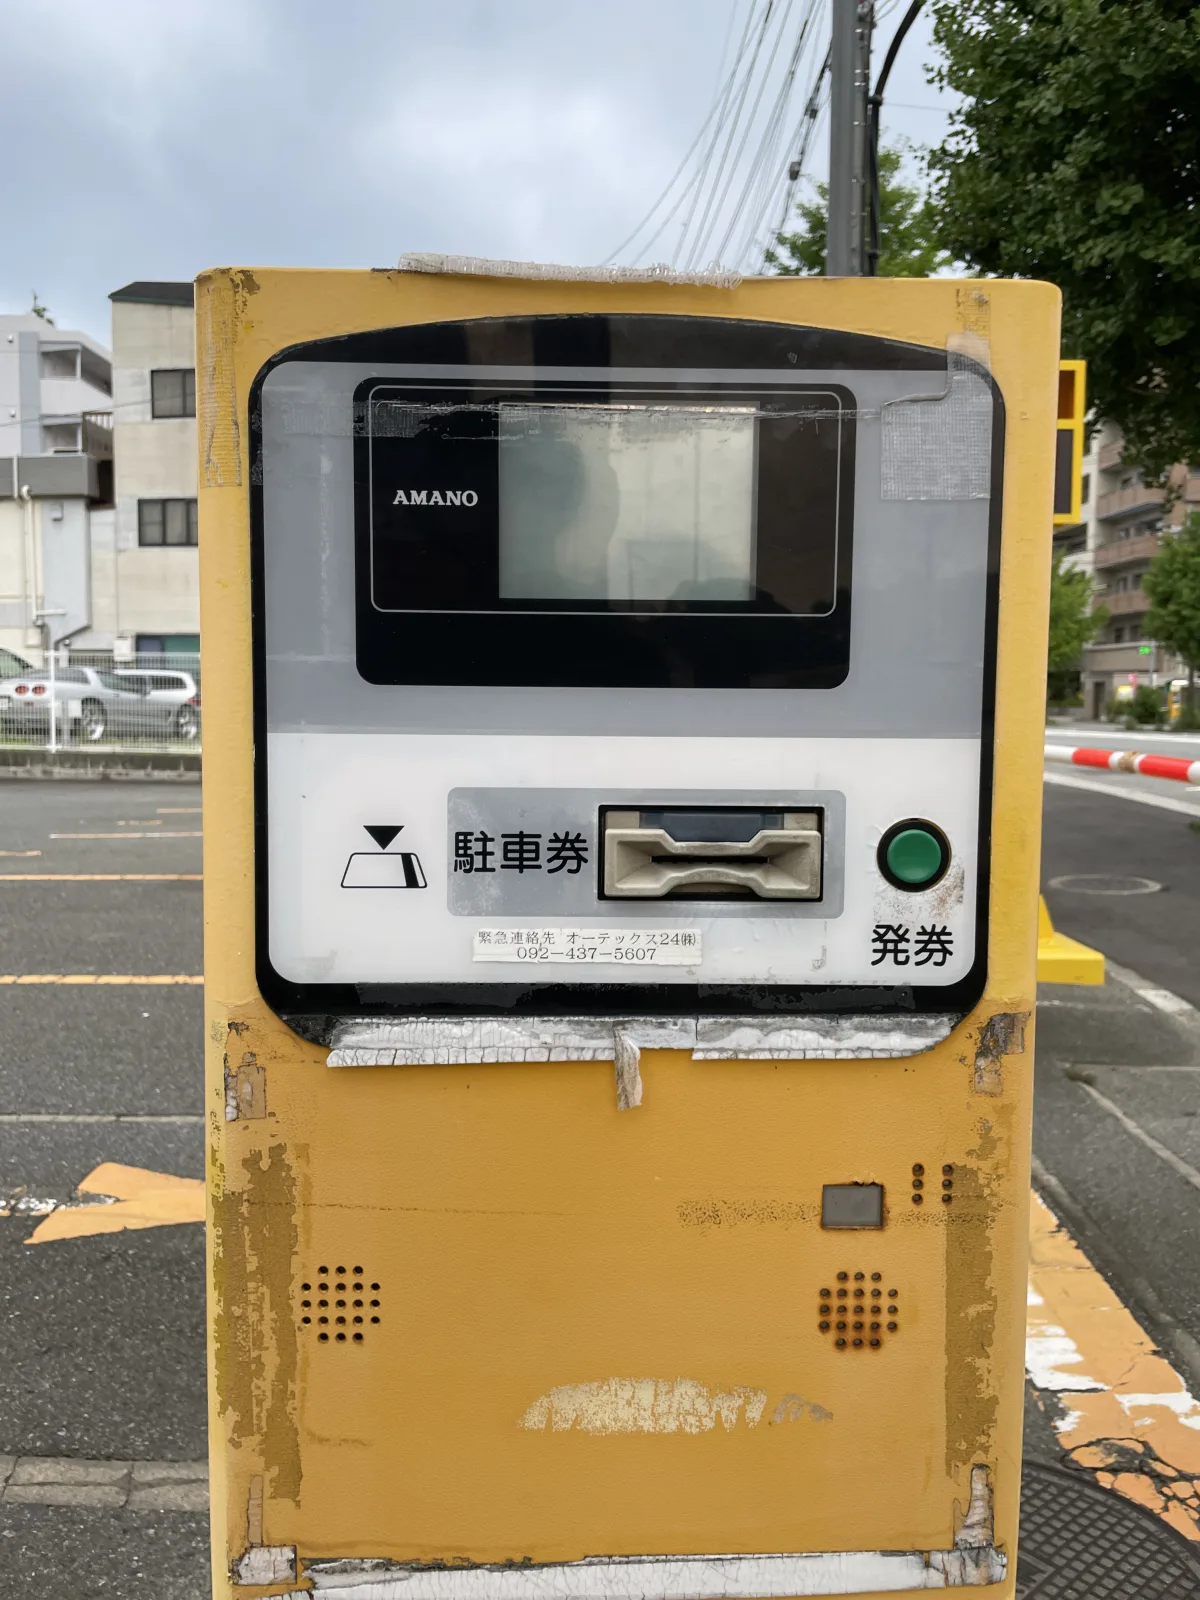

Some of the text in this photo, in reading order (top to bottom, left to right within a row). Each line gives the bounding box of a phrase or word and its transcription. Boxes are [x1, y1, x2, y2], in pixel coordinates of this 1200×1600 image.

[392, 489, 478, 507] AMANO
[453, 830, 589, 874] 駐車券
[477, 931, 556, 946] 緊急連絡先
[870, 923, 954, 967] 発券
[516, 946, 657, 962] 092-437-5607
